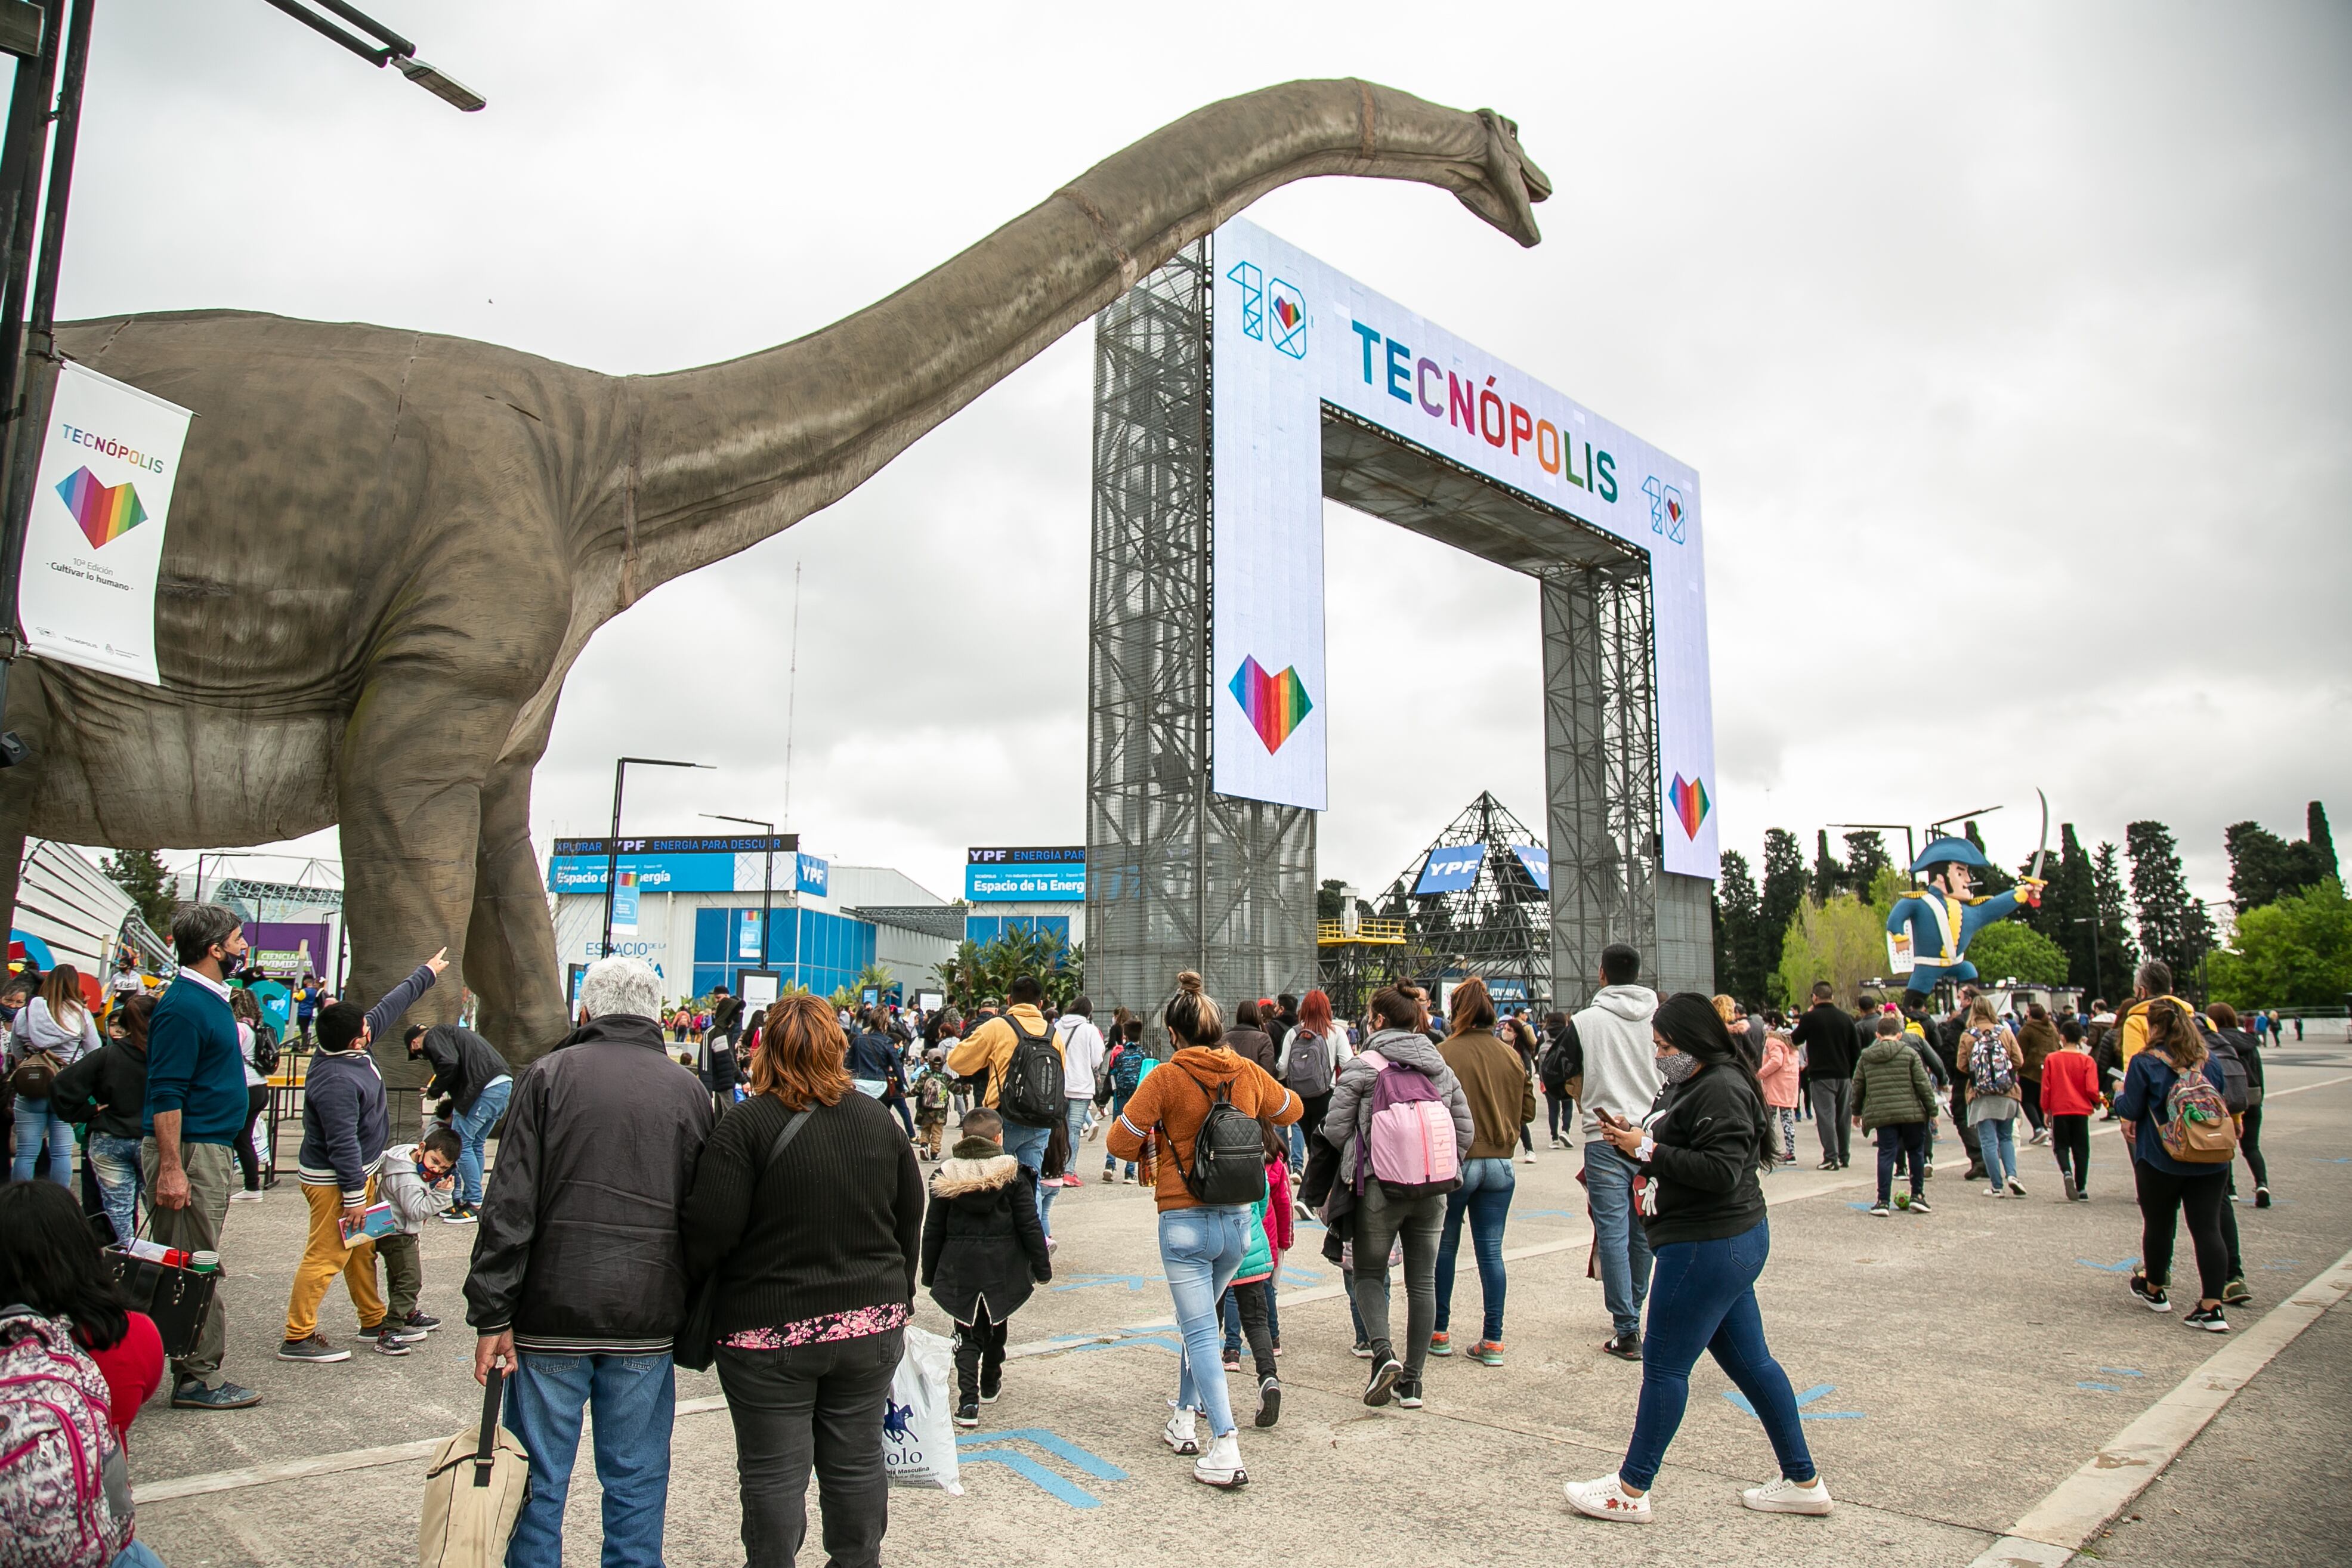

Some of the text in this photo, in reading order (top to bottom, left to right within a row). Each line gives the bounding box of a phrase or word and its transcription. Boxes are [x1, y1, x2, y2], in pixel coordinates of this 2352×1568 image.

[1351, 318, 1618, 503] TECNÓPOLIS
[63, 423, 164, 474] TECNÓPOLIS
[51, 562, 85, 578] Cultivar
[86, 572, 94, 581] lo
[96, 574, 129, 590] humano
[87, 562, 113, 576] Edición
[701, 840, 728, 850] PARA
[731, 839, 781, 850] DESCUR
[970, 851, 1007, 861] YPF
[1064, 850, 1085, 860] PAR
[802, 865, 824, 884] YPF
[1431, 859, 1479, 876] YPF
[1523, 859, 1549, 874] YP
[557, 871, 599, 886] Espacio
[973, 879, 1084, 893] Espacio de la Energ
[586, 942, 648, 955] ESACIO
[1427, 1107, 1452, 1174] PUMA
[883, 1448, 922, 1465] olo
